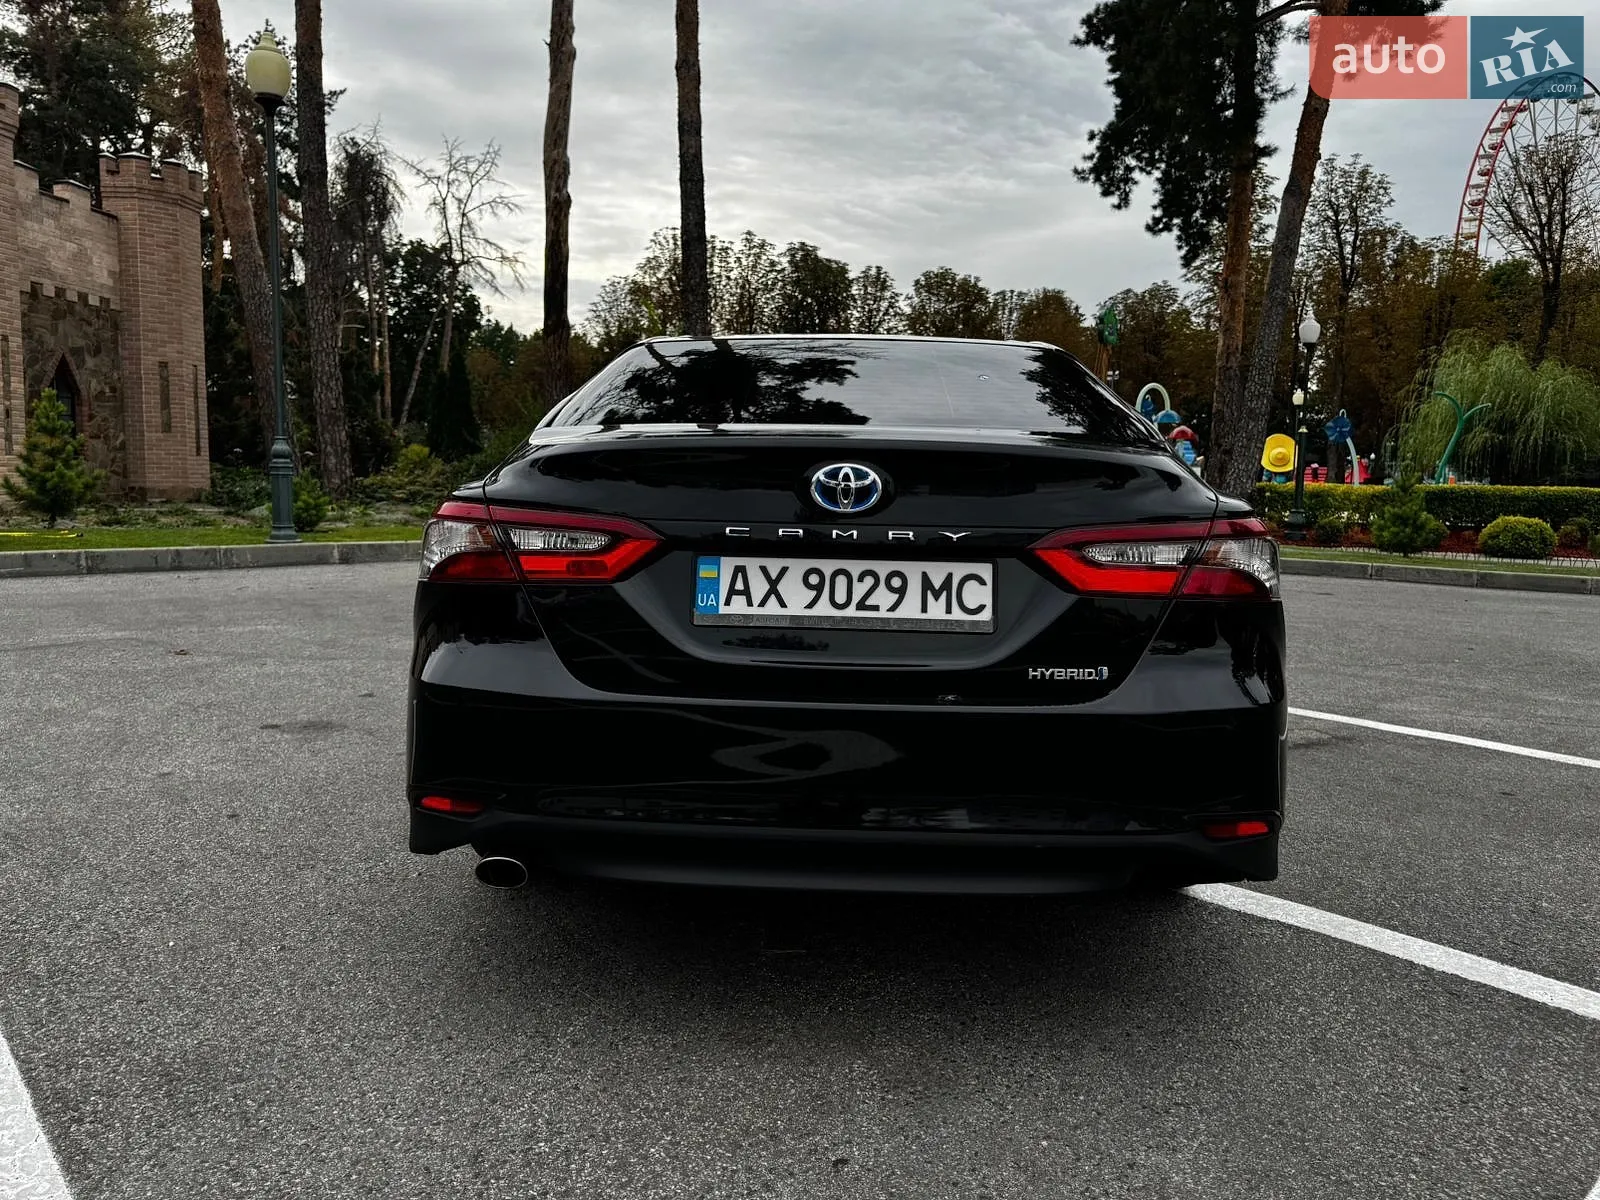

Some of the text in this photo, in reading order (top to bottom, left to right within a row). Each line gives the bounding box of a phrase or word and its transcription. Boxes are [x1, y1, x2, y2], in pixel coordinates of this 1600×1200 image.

[724, 526, 972, 542] CAMRY
[723, 565, 988, 616] AX 9029 MC
[698, 594, 717, 608] UA
[1028, 668, 1096, 680] HYBRID
